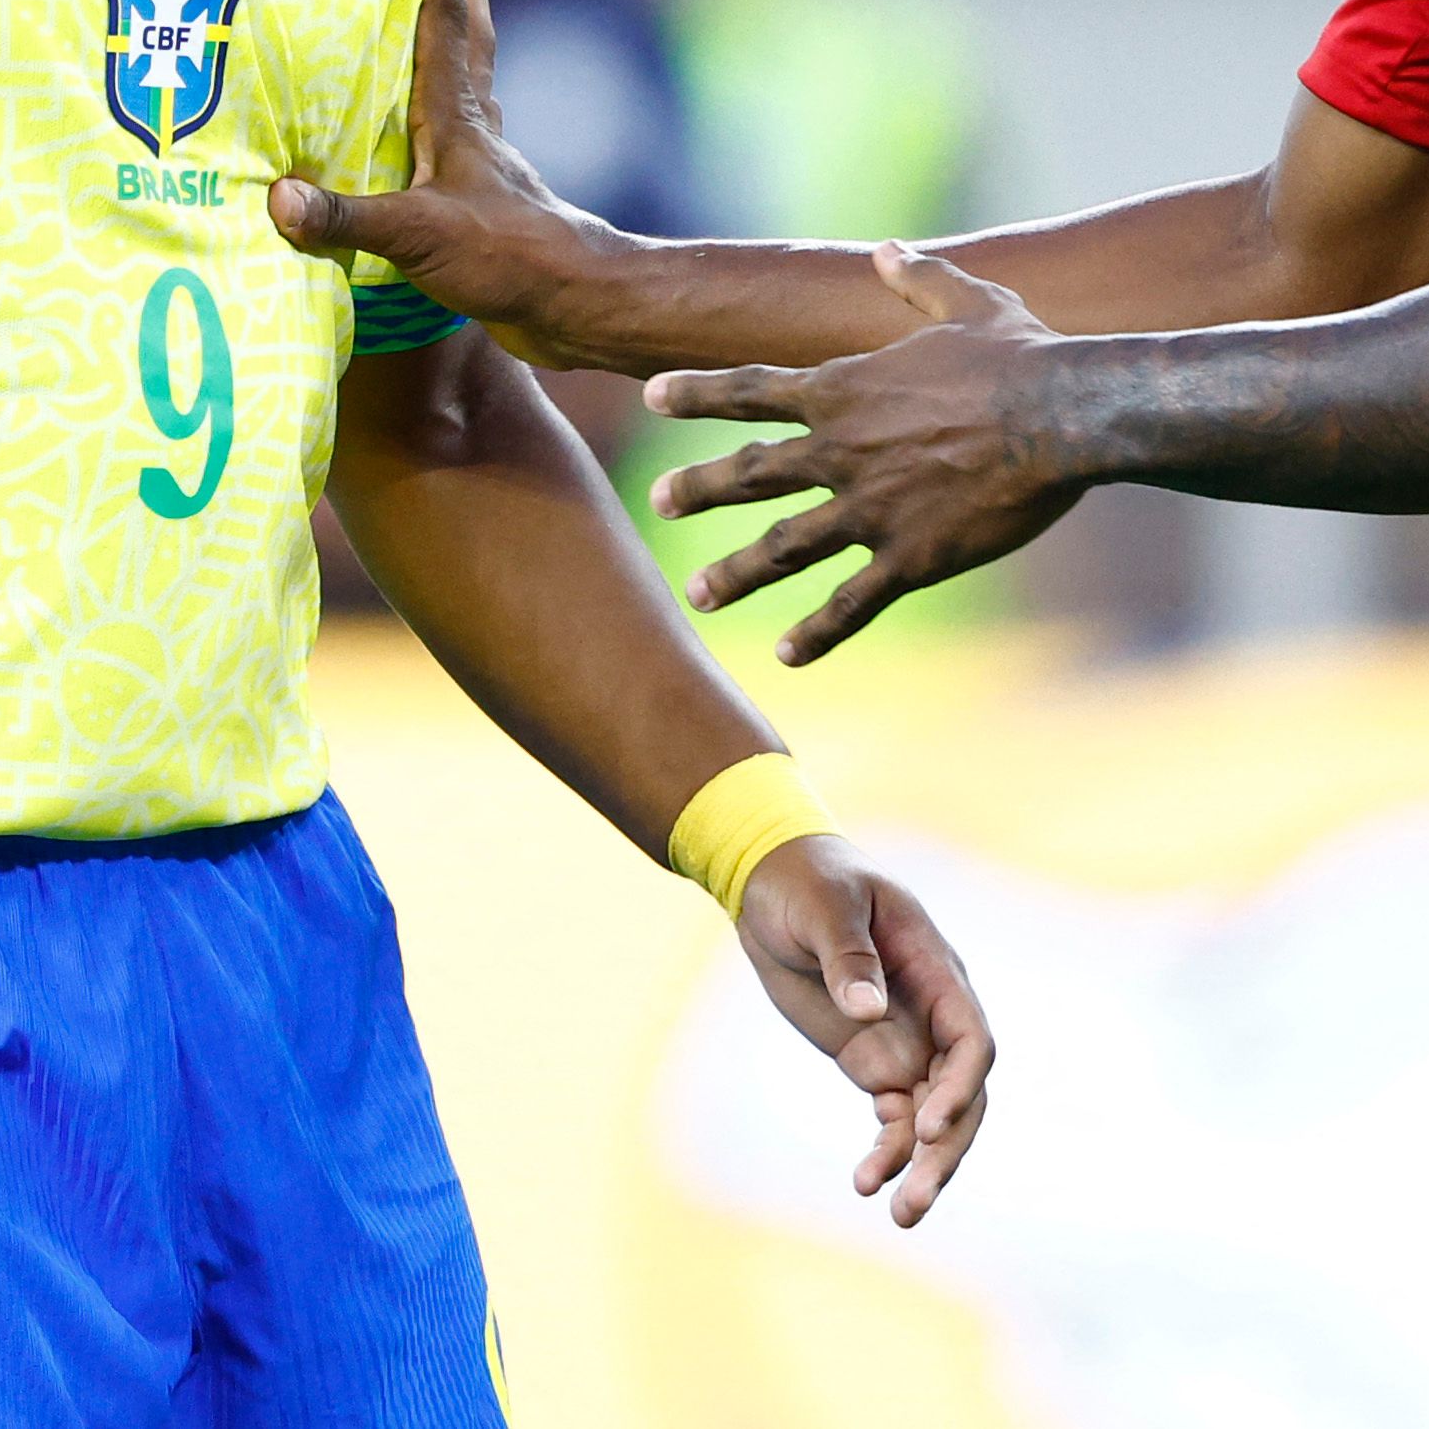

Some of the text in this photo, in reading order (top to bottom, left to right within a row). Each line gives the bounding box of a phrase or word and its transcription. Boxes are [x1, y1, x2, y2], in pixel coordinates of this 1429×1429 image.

[142, 25, 191, 51] CBF
[117, 163, 225, 208] BRASIL
[138, 266, 234, 520] 9
